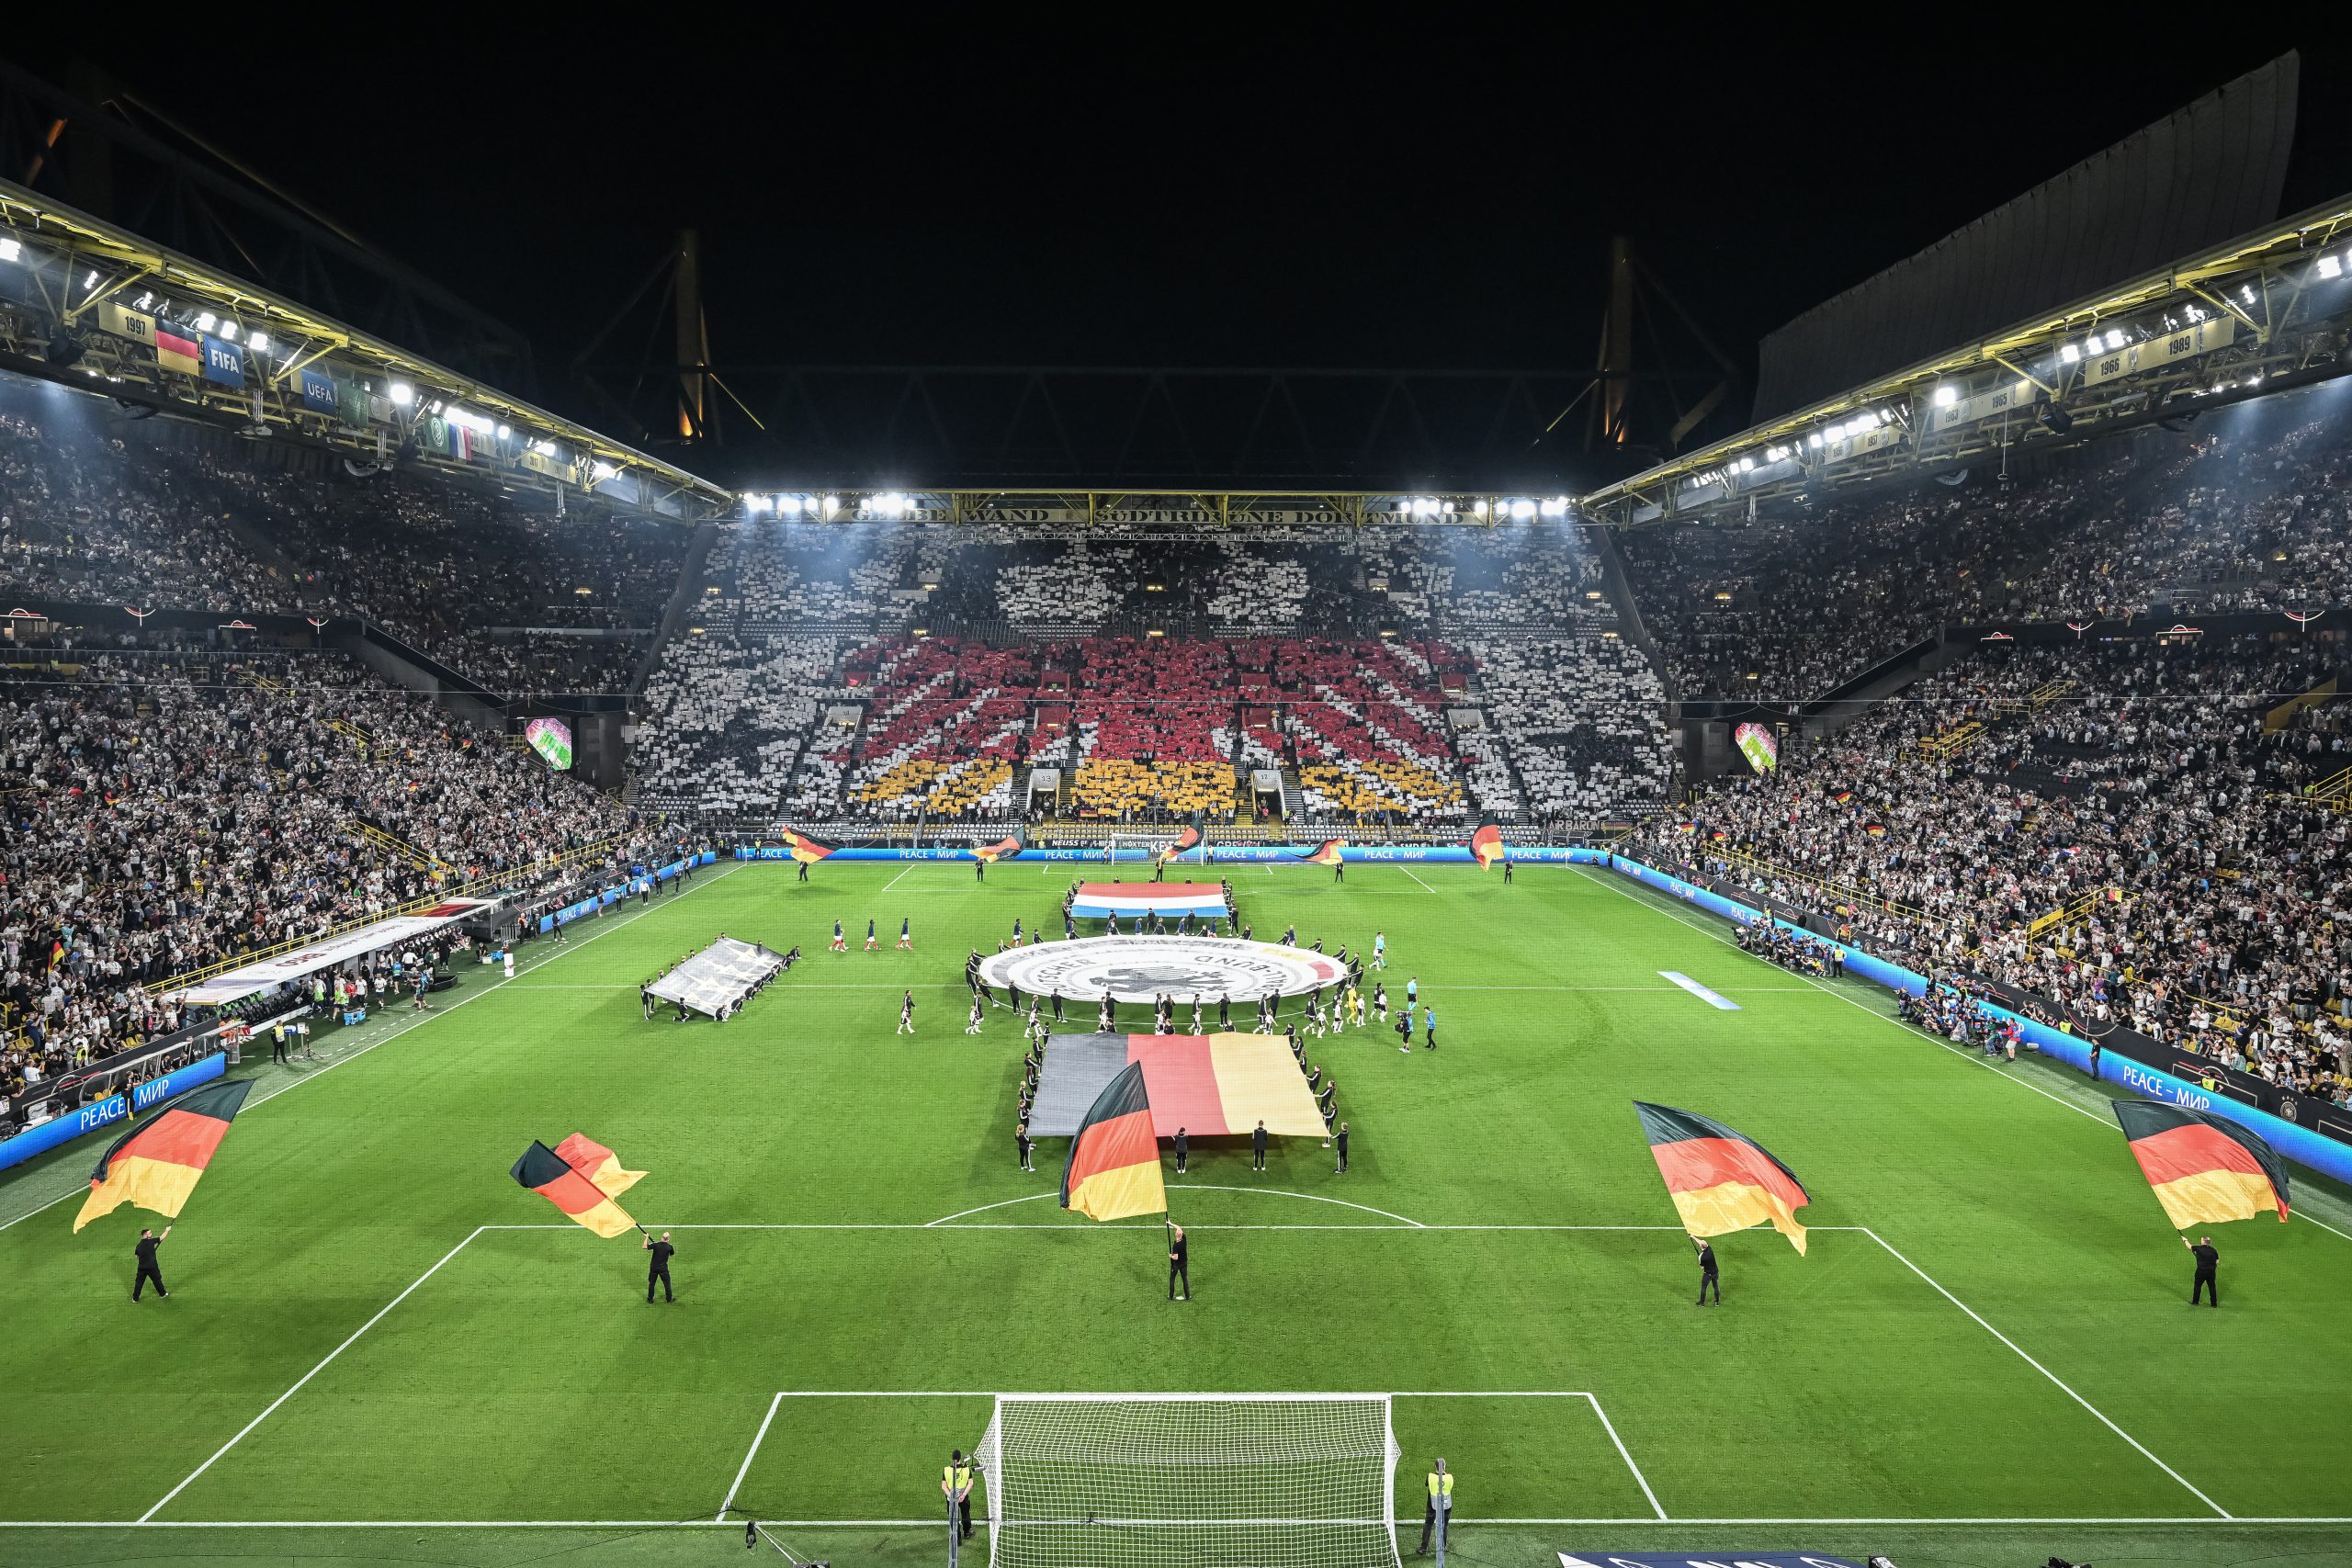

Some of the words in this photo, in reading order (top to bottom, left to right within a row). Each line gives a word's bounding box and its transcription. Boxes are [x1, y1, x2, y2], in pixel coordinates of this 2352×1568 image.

[125, 315, 146, 336] 1997
[2169, 335, 2191, 355] 1989
[210, 349, 240, 374] FIFA
[2100, 357, 2120, 377] 1966
[307, 381, 333, 403] UEFA
[1992, 393, 2007, 409] 1965
[1945, 411, 1959, 423] 1963
[966, 509, 1049, 522] WAND
[1094, 509, 1283, 523] SÜDTRIBÜNE
[1295, 510, 1464, 525] DORTMUND
[1041, 774, 1052, 783] 13
[757, 850, 782, 858] EACE
[899, 851, 928, 859] PEACE
[1217, 850, 1247, 858] PEACE
[1364, 851, 1395, 859] PEACE
[1511, 851, 1542, 859] PEACE
[1731, 906, 1746, 920] PEACE
[2123, 1065, 2164, 1097] PEACE
[2176, 1087, 2210, 1111] МИР
[80, 1098, 125, 1131] PEACE
[139, 1079, 169, 1106] МИР
